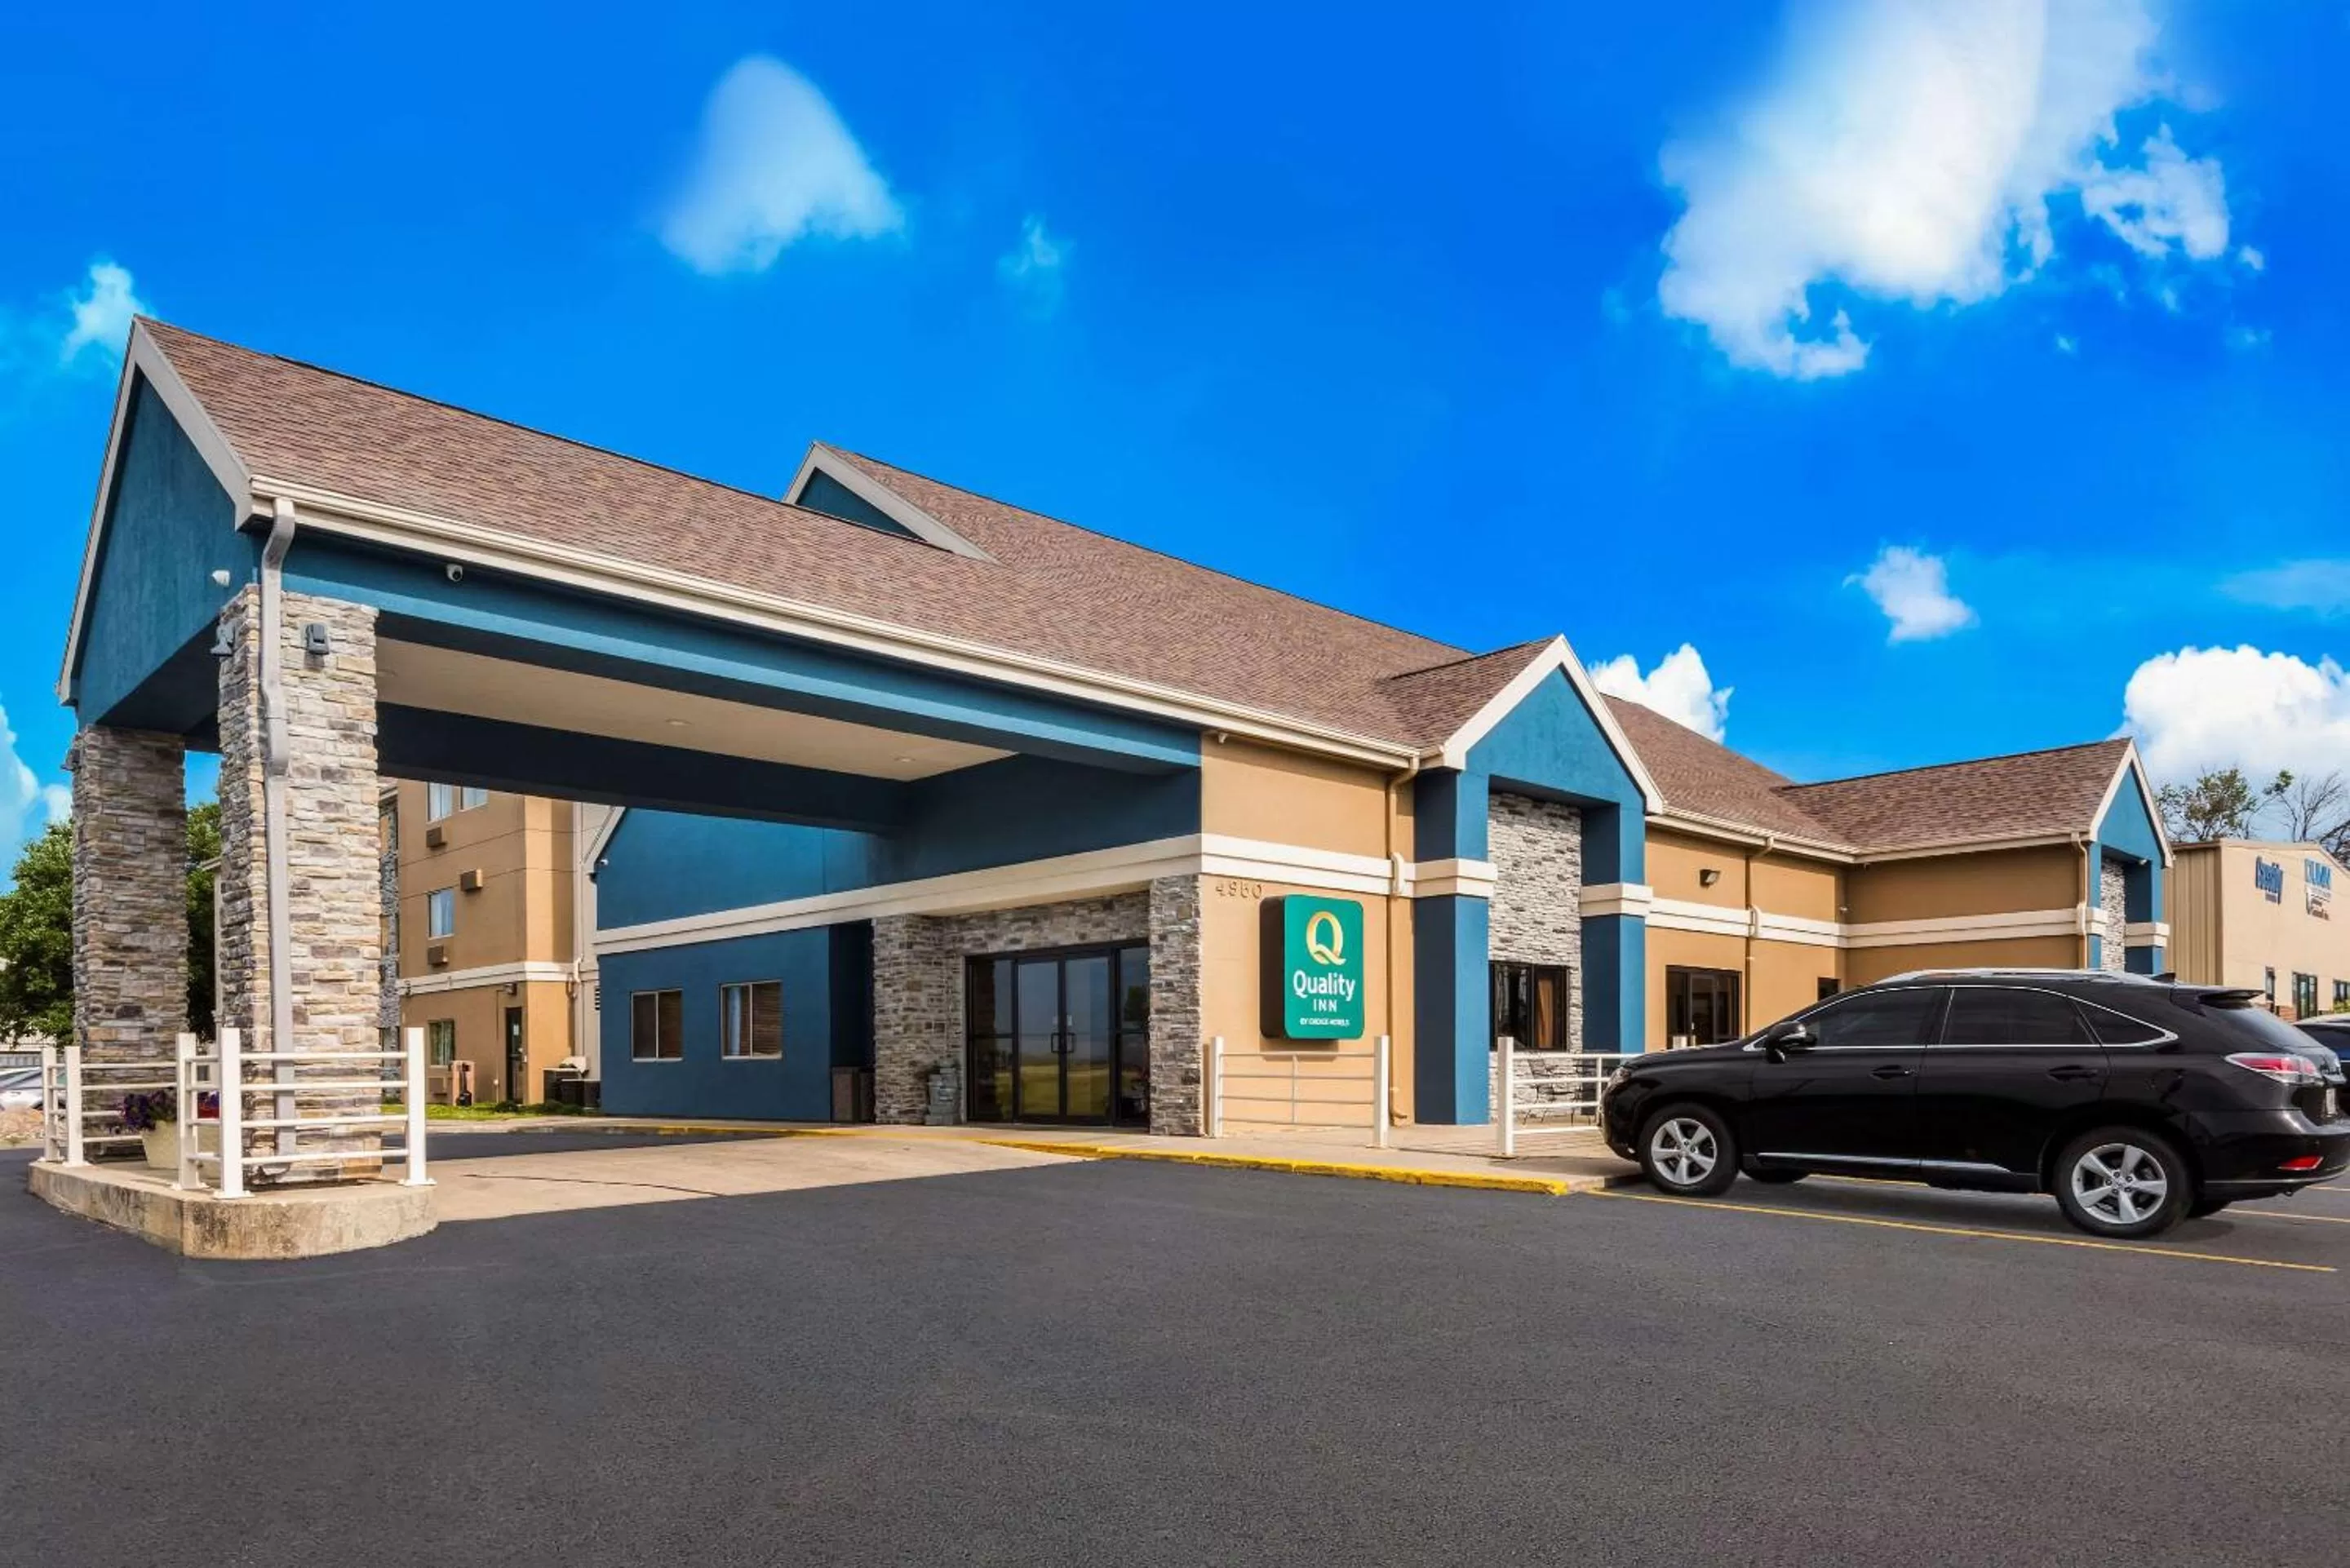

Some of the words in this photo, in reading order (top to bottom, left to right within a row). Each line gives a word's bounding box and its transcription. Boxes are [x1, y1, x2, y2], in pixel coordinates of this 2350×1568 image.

[1306, 911, 1346, 965] Q
[1293, 969, 1355, 1001] Quality
[1313, 999, 1337, 1012] INN
